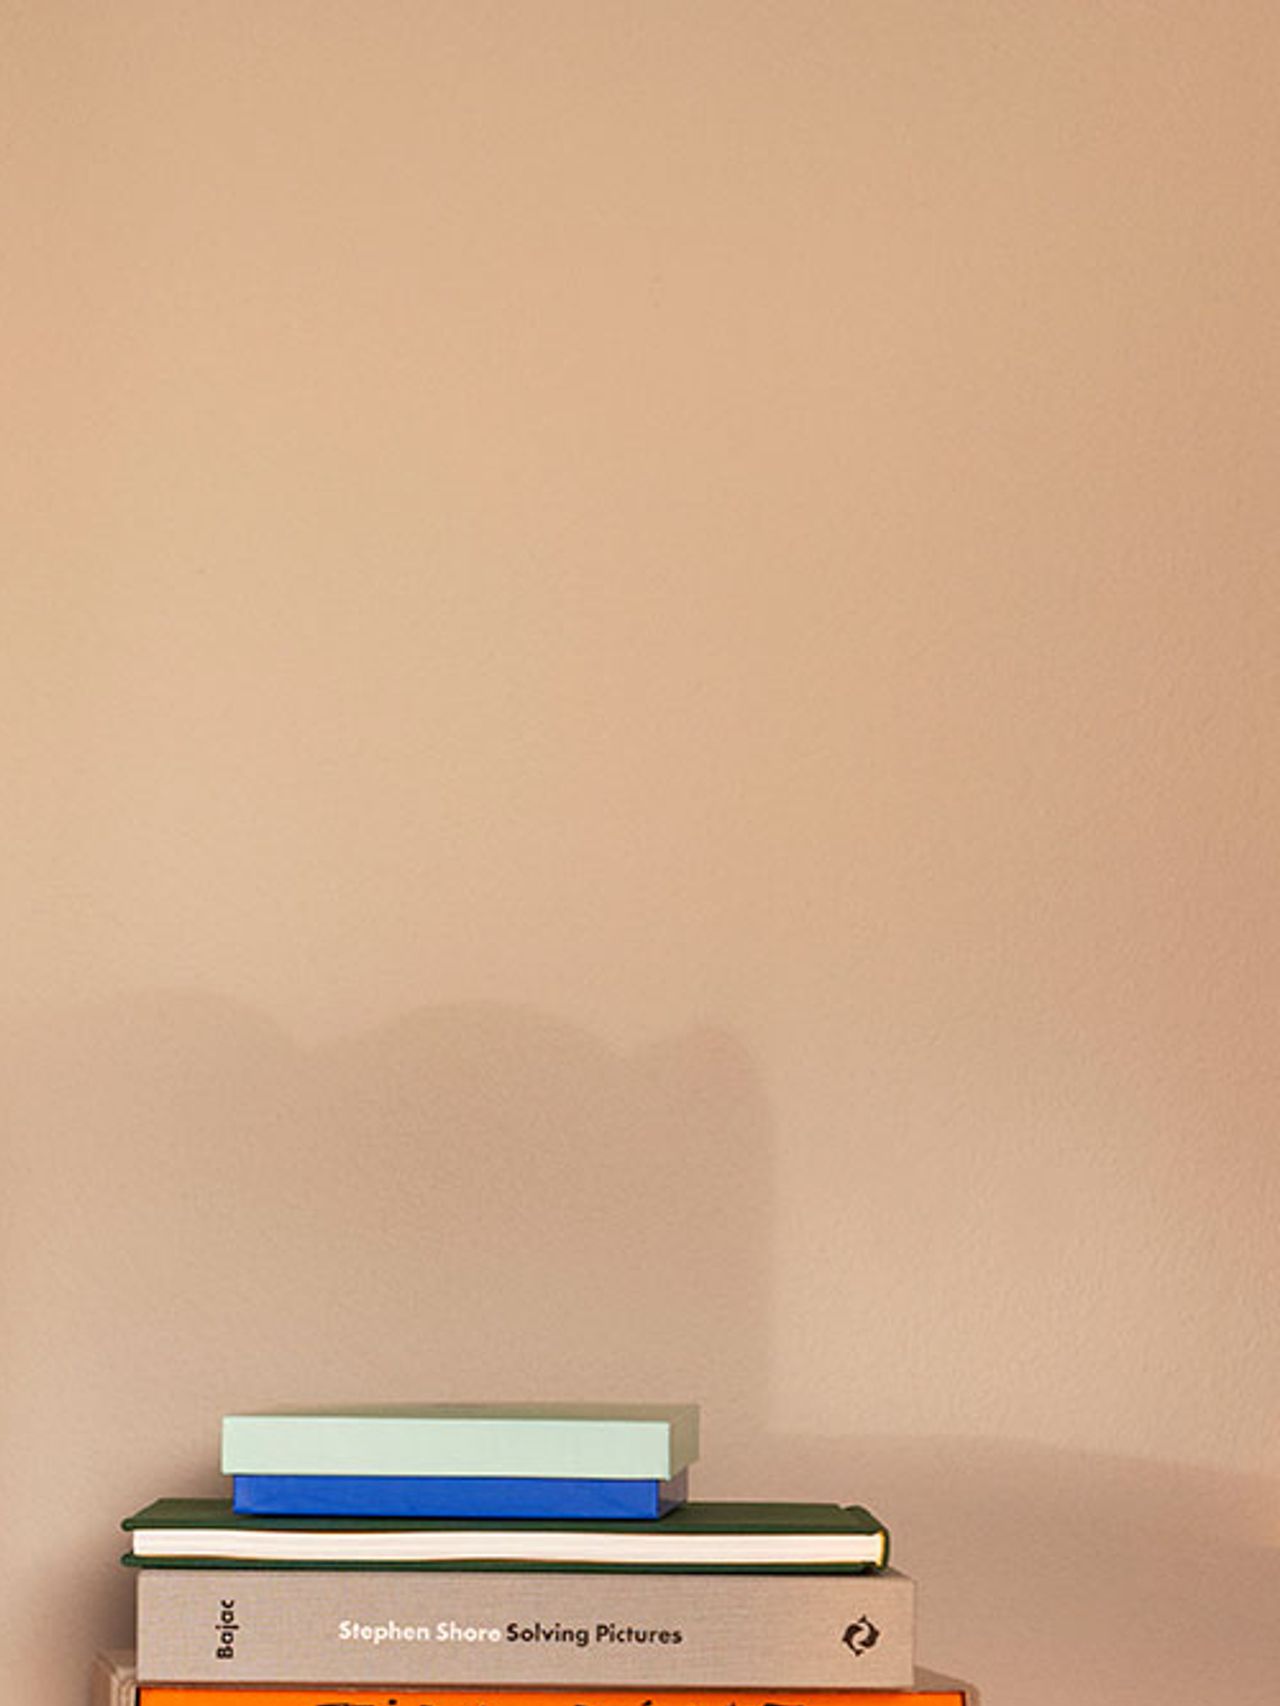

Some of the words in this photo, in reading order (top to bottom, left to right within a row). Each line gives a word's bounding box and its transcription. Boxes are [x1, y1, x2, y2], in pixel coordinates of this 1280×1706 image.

[215, 1600, 239, 1659] Bajac
[338, 1620, 430, 1644] Stephen
[435, 1621, 502, 1643] Shore
[506, 1623, 589, 1648] Solving
[596, 1624, 683, 1645] Pictures
